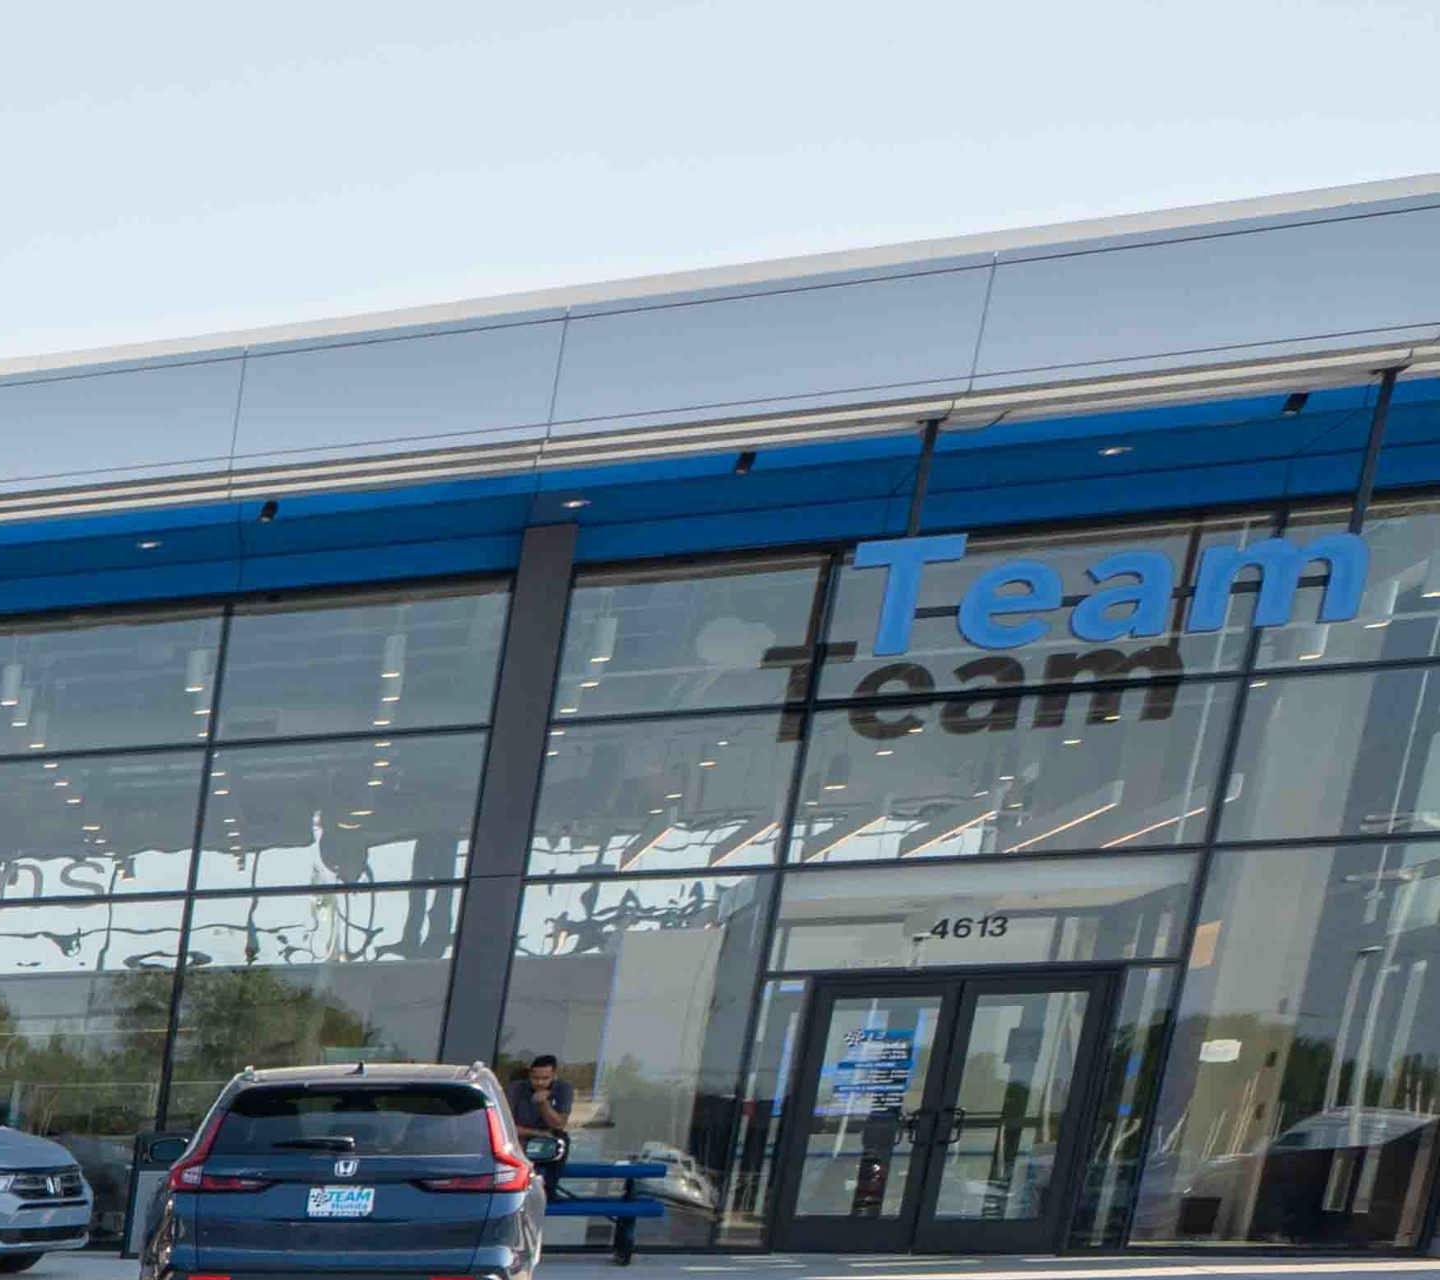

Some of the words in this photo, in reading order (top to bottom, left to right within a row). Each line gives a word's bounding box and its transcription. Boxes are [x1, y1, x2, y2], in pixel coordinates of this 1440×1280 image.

[852, 533, 1371, 657] Team
[930, 916, 1009, 939] 4613
[329, 1191, 372, 1202] TEAM
